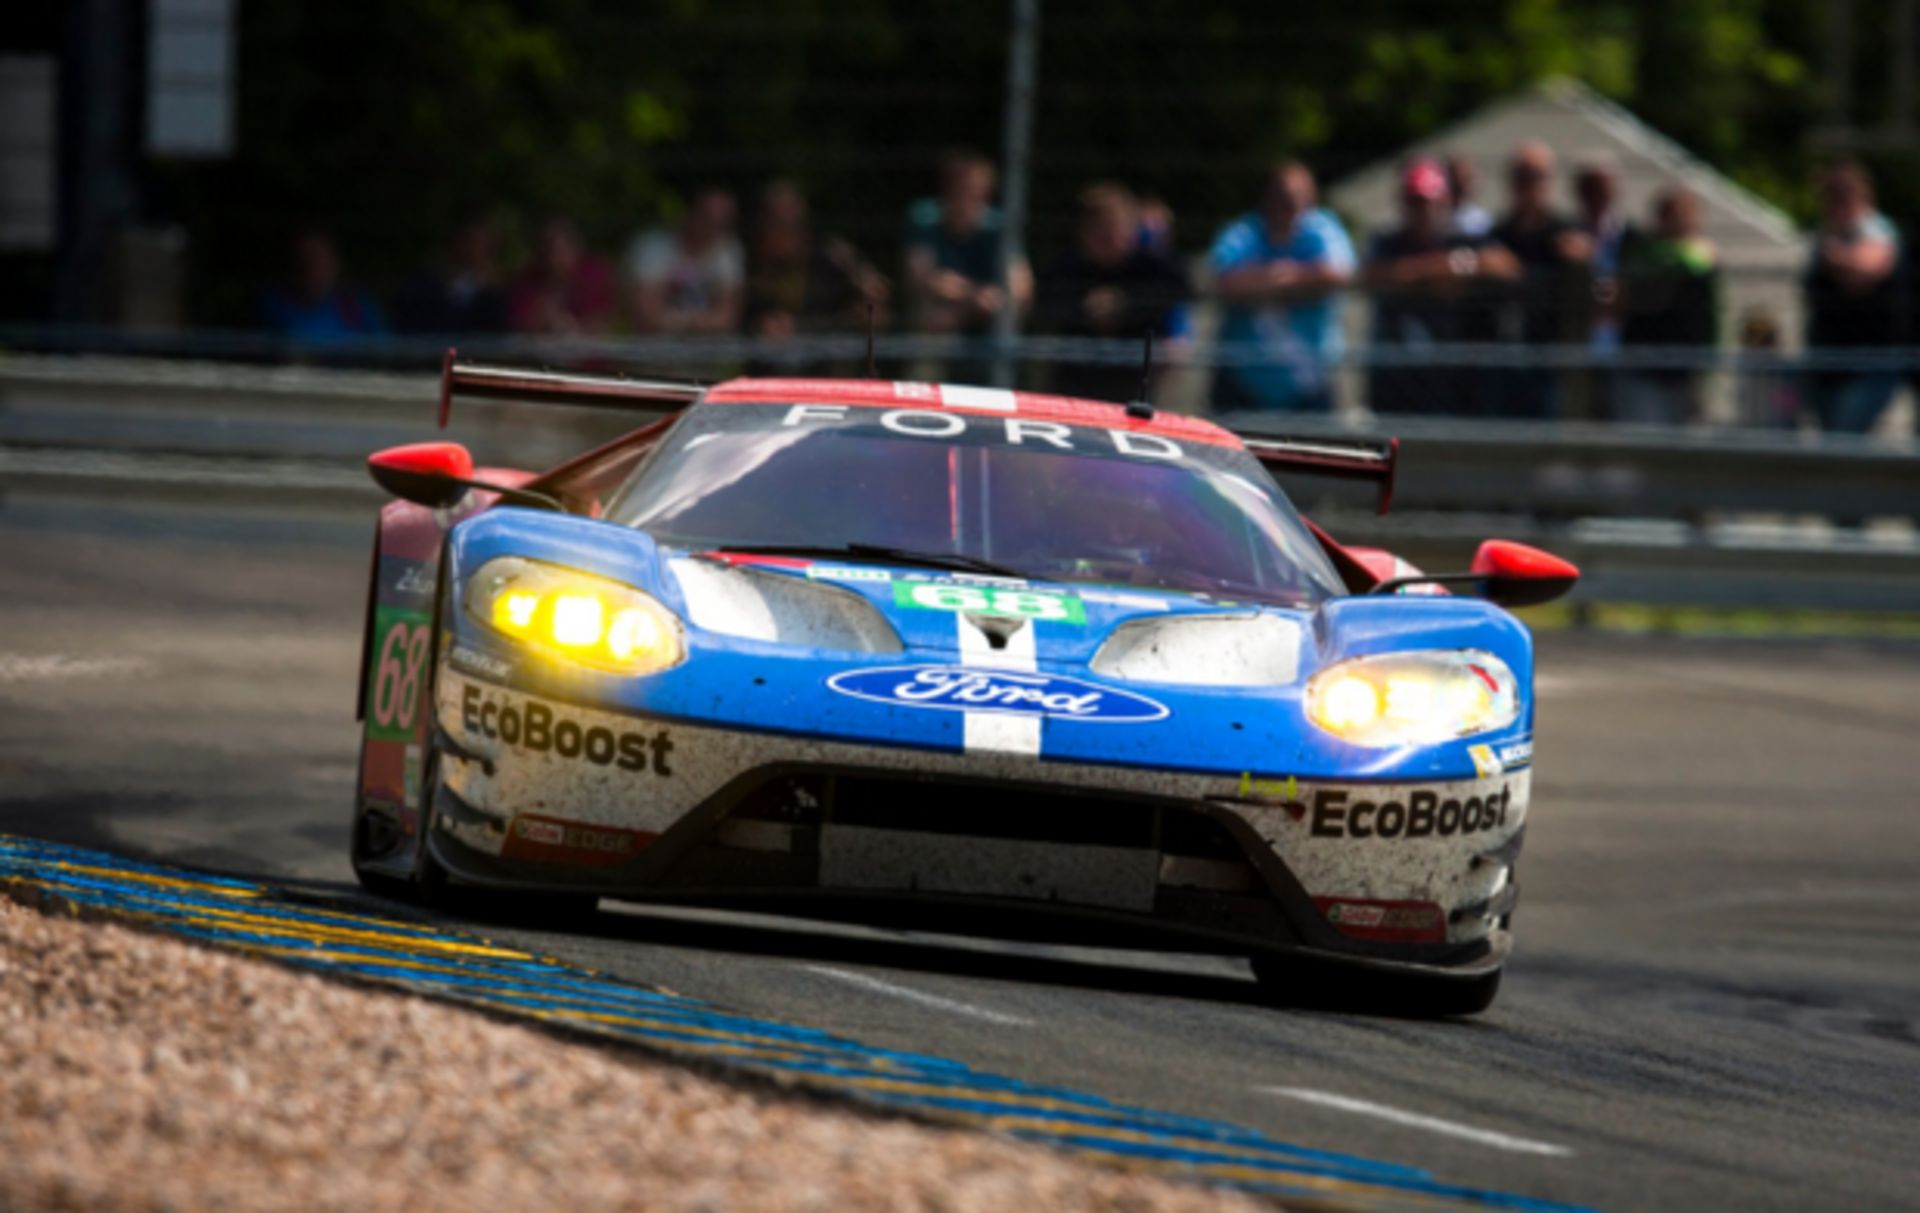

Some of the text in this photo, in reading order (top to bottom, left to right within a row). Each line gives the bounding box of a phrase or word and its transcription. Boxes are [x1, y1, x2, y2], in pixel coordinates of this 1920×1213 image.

[782, 403, 1184, 460] FORD
[911, 584, 1069, 618] 68
[373, 622, 431, 728] 68
[893, 668, 1102, 715] Ford
[462, 684, 674, 777] EcoBoost
[1311, 784, 1511, 838] EcoBoost
